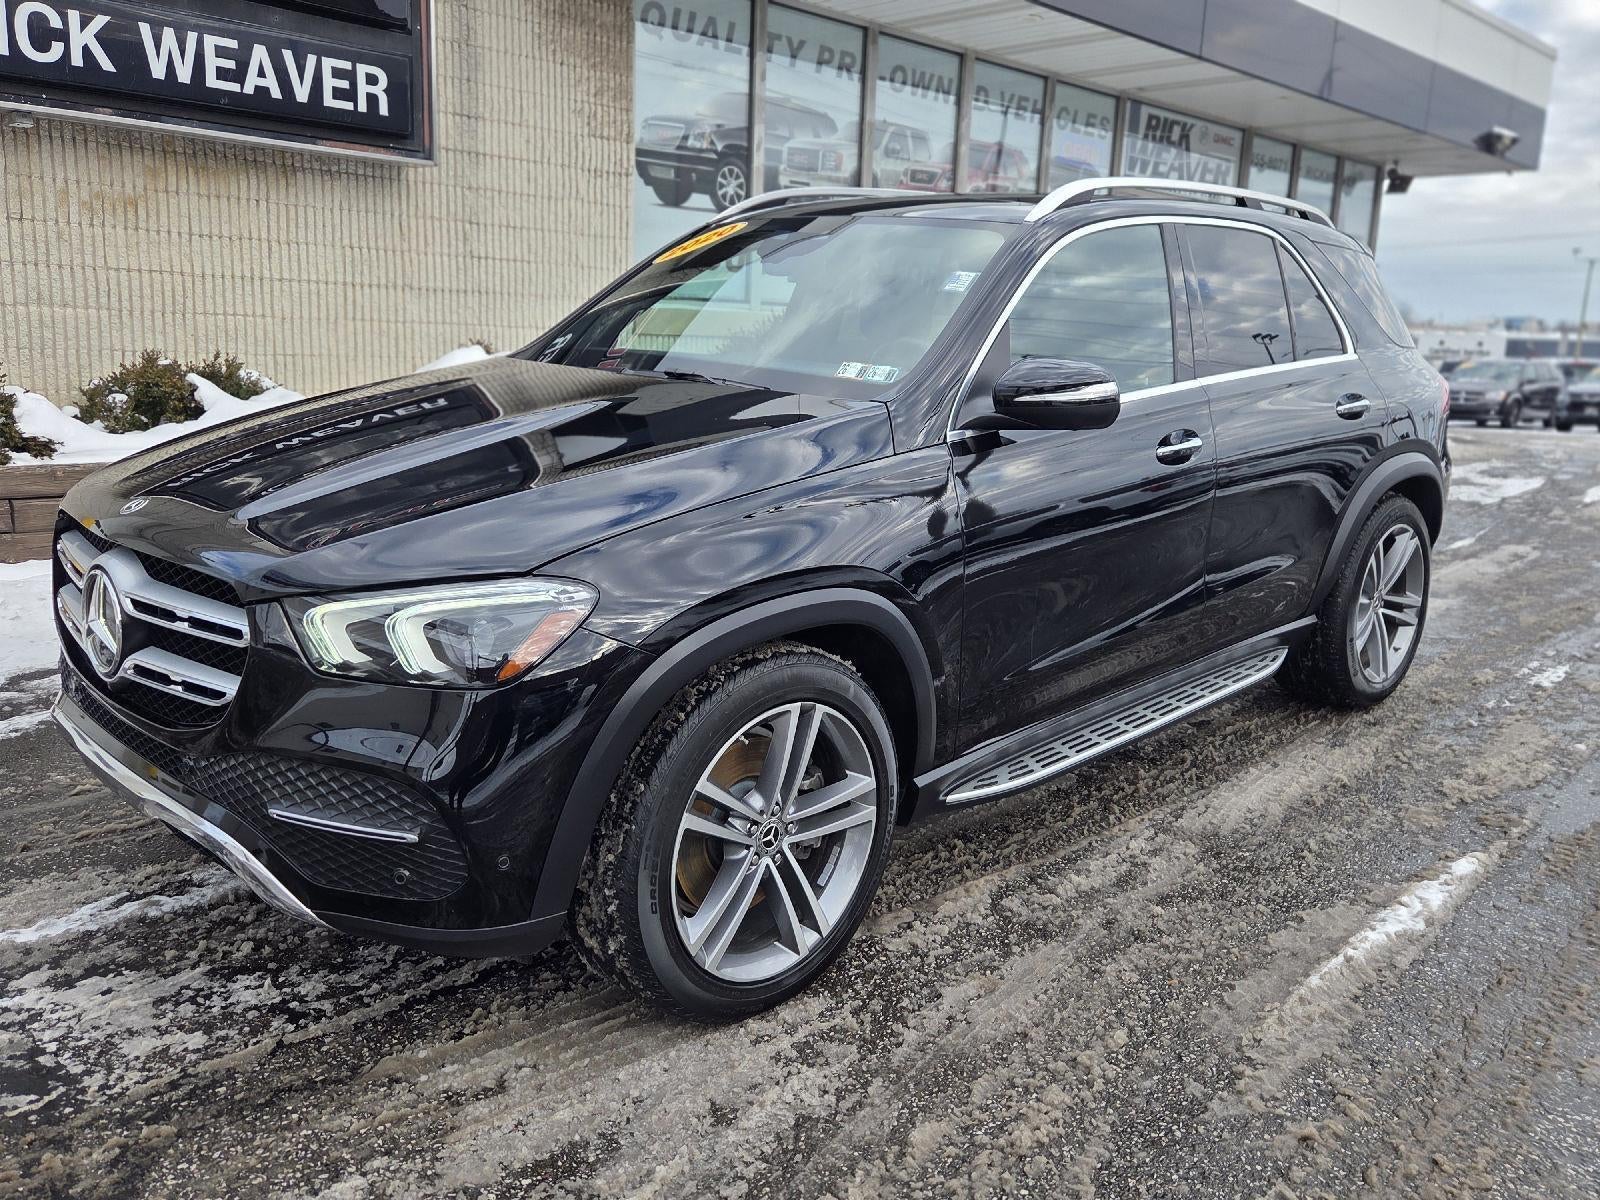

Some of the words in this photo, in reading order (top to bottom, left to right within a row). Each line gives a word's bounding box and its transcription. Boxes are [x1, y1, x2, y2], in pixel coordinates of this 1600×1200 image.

[138, 21, 389, 117] WEAVER
[641, 1, 806, 68] QUALTY
[815, 44, 990, 112] PR-OWND
[999, 90, 1111, 140] VEHCLES
[1126, 140, 1234, 187] WEAVER
[1143, 112, 1198, 152] RICK
